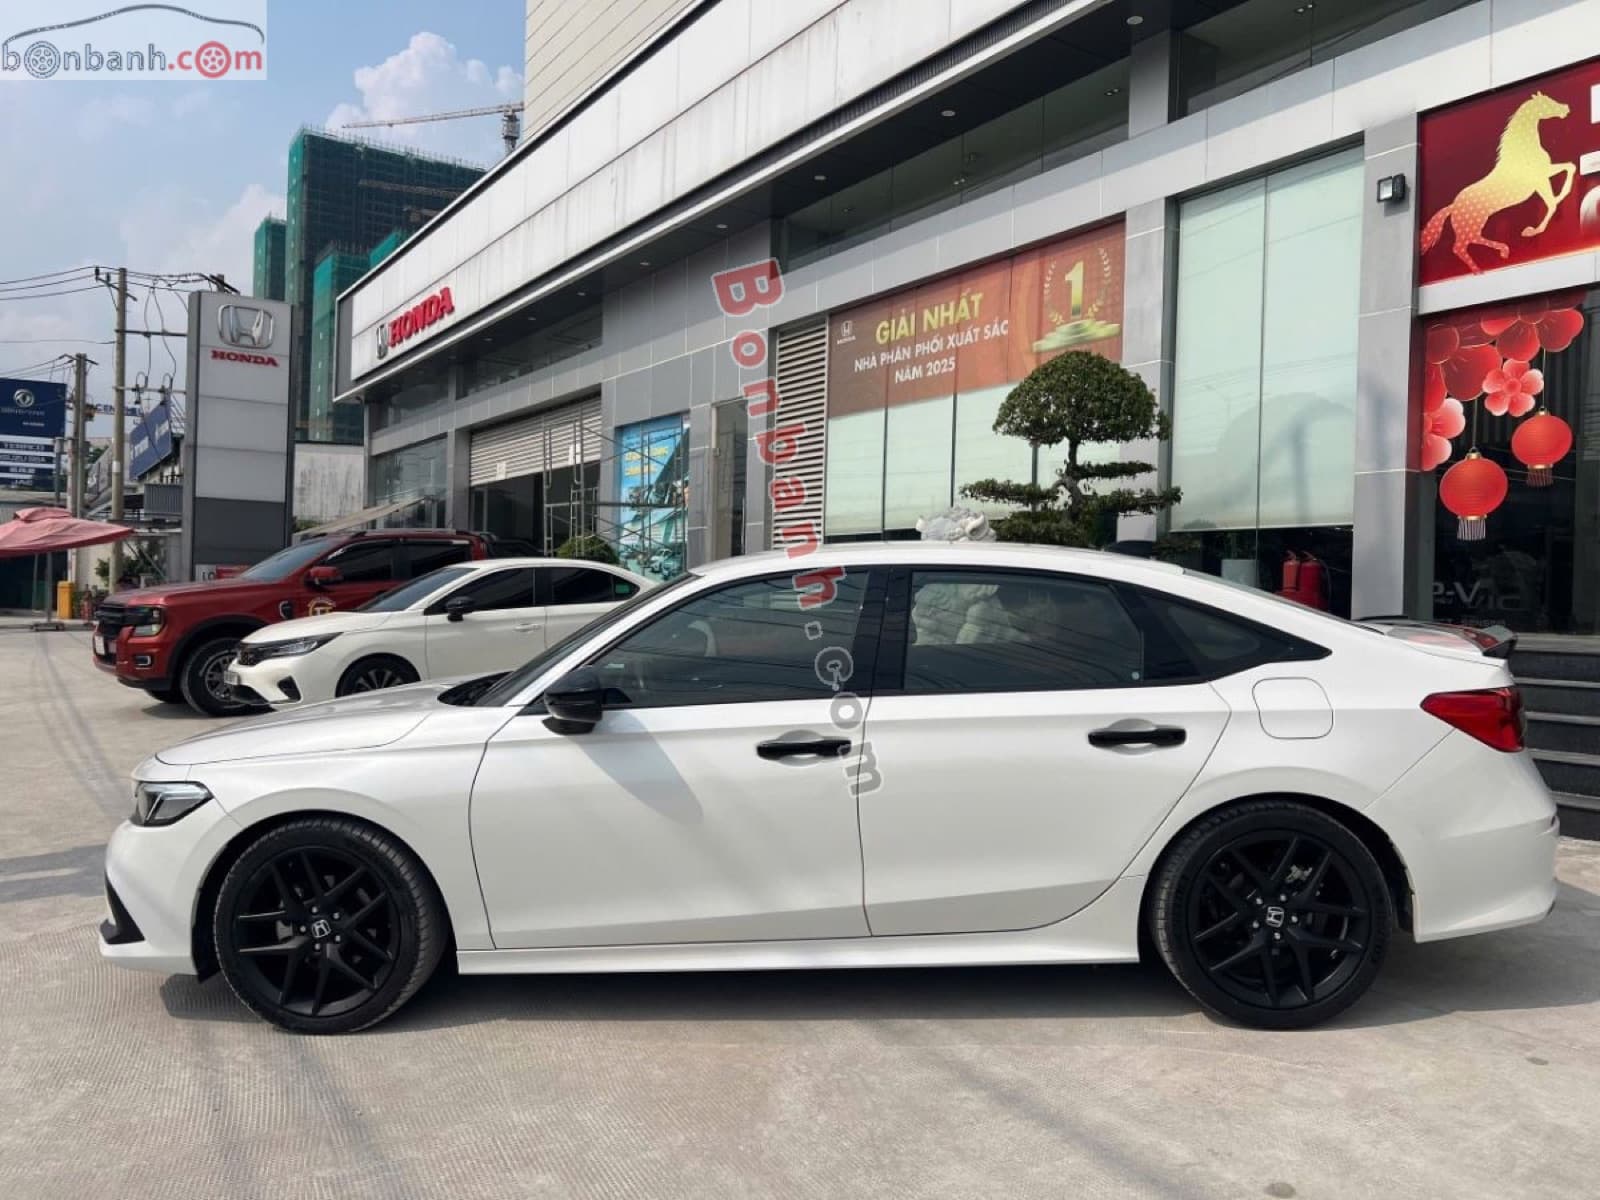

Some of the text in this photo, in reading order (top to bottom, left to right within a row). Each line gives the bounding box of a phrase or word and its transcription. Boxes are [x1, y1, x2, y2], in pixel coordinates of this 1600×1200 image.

[1065, 260, 1084, 317] 1
[389, 287, 455, 349] HONDA
[854, 352, 877, 373] NHÀ
[915, 335, 944, 358] PHỐI
[947, 324, 981, 349] XUẤT
[984, 317, 1009, 340] SẮC
[875, 289, 983, 345] GIẢI NHẤT
[211, 350, 279, 367] HONDA
[895, 357, 956, 384] NĂM 2025
